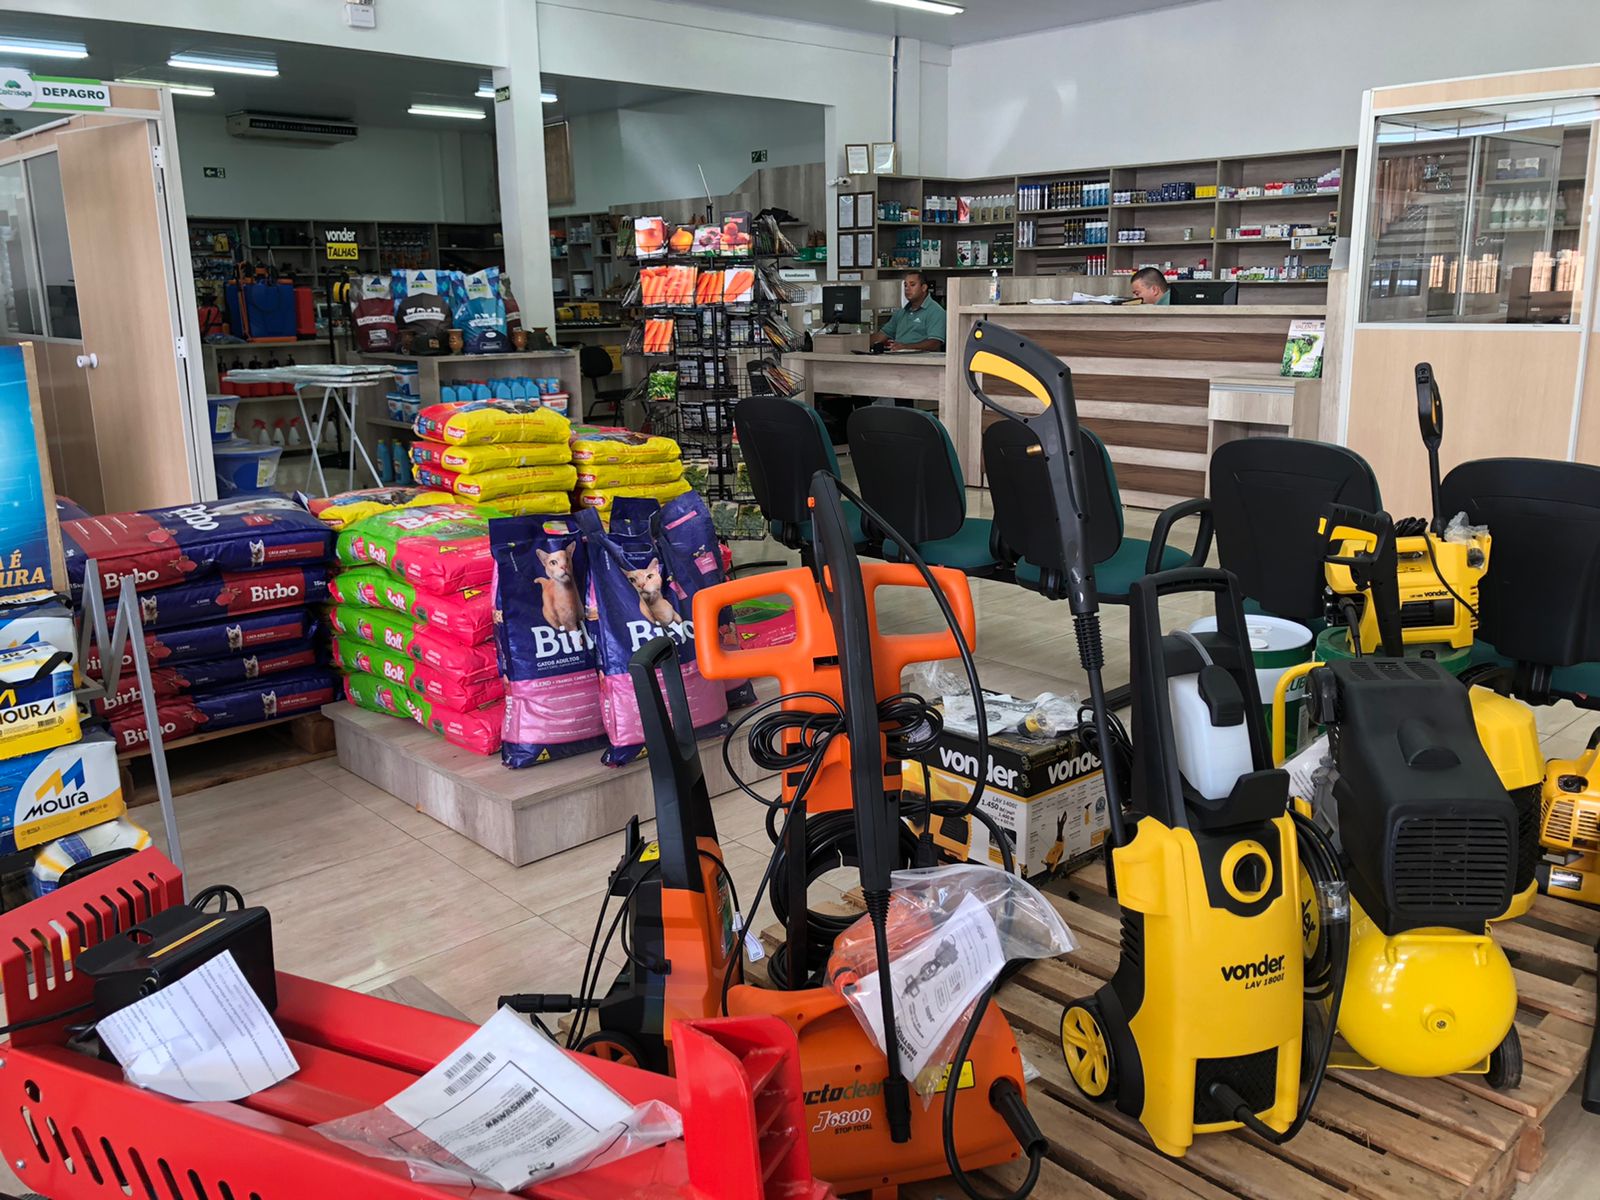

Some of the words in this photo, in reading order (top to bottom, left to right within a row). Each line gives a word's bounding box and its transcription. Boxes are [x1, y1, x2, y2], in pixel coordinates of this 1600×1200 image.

[42, 87, 105, 100] DEPAGRO
[325, 227, 356, 241] vonder
[327, 246, 357, 257] TALHAS
[368, 543, 387, 565] Bolt
[0, 567, 45, 588] URA
[251, 584, 299, 602] Birbo
[1424, 589, 1448, 597] vonder
[385, 629, 403, 650] Bolt
[385, 662, 405, 684] Bolt
[0, 701, 56, 725] OURA
[981, 799, 999, 810] 1.450
[1221, 954, 1285, 981] vonder
[1245, 980, 1261, 990] LAV
[812, 1108, 871, 1132] J6800
[835, 1126, 853, 1134] STOP
